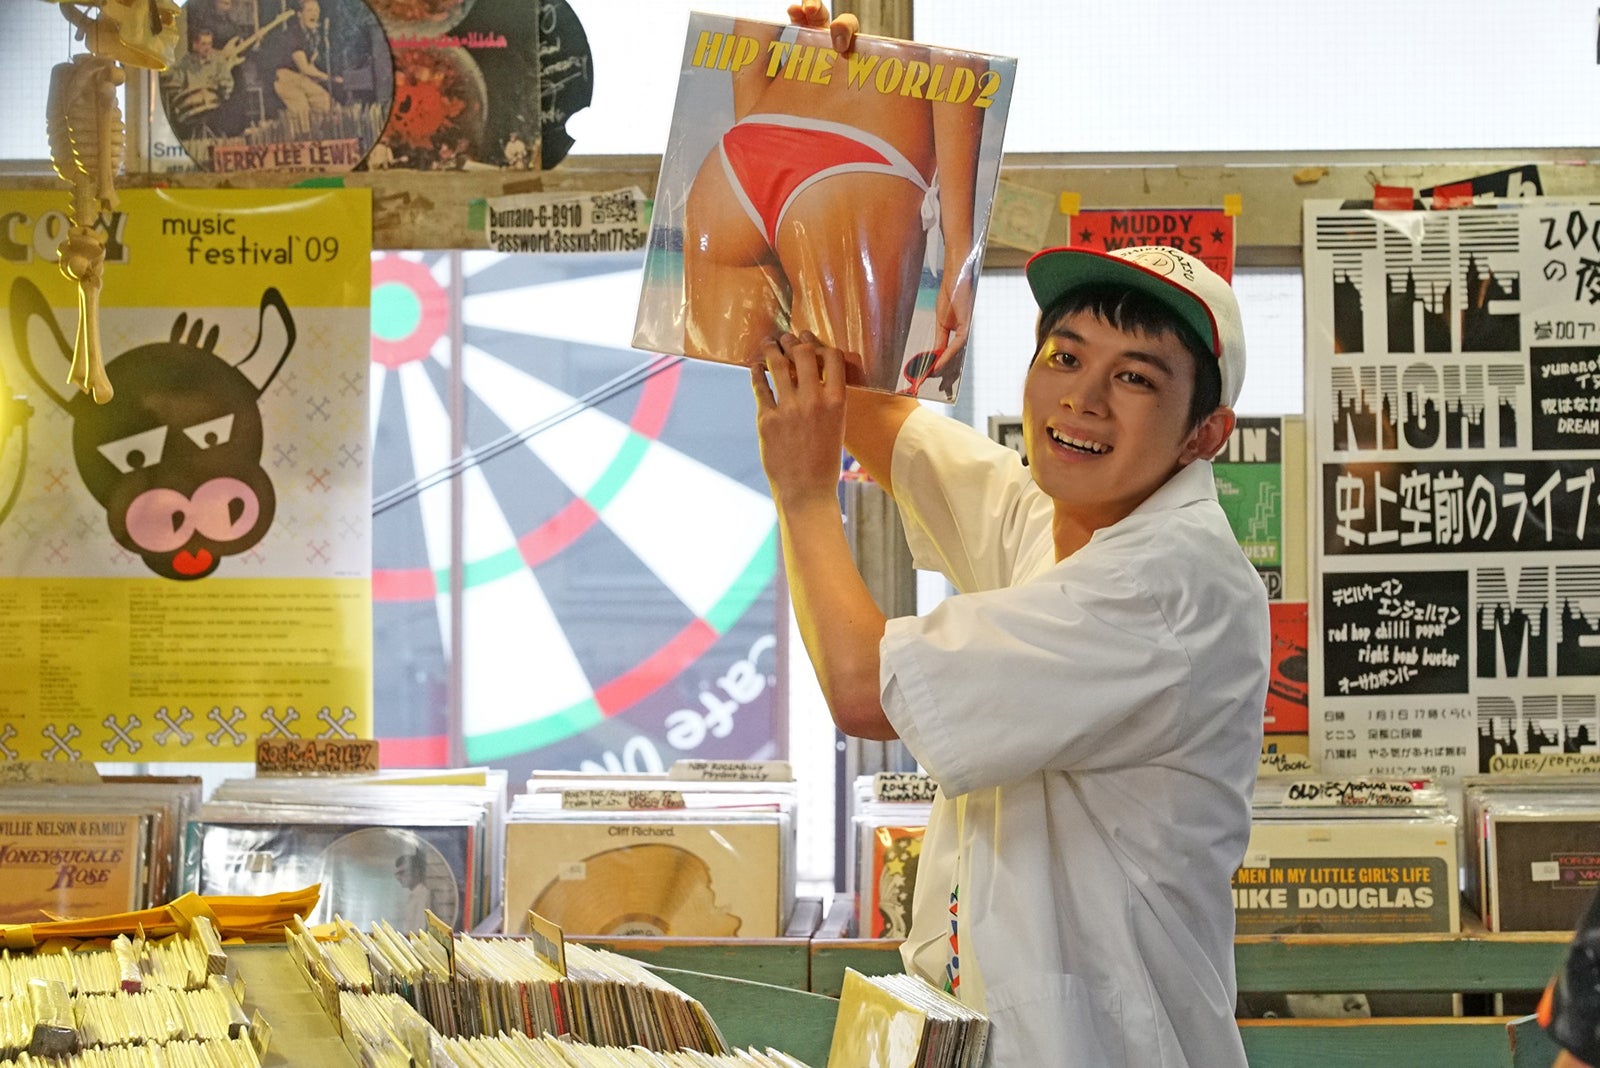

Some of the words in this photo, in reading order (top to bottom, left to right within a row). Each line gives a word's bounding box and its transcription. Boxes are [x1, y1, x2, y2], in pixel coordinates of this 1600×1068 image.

[691, 31, 760, 72] HIP
[766, 40, 839, 85] THE
[274, 149, 302, 165] LEE
[162, 214, 236, 235] music
[1110, 215, 1194, 234] MUDDY
[1557, 418, 1600, 435] DREAM
[1332, 578, 1403, 607] デビルウーマン
[1377, 597, 1461, 625] エンジェルマン
[1358, 644, 1390, 665] right
[1422, 646, 1461, 668] buster
[36, 821, 77, 836] NELSON
[79, 821, 87, 836] &
[89, 821, 127, 836] FAMILY
[608, 826, 631, 837] Cliff
[1238, 867, 1267, 884] MEN
[1270, 867, 1284, 884] IN
[1287, 867, 1307, 884] MY
[1310, 867, 1356, 883] LITTLE
[1358, 867, 1400, 883] GIRL'S
[1402, 867, 1431, 883] LIFE
[1298, 886, 1434, 909] DOUGLAS
